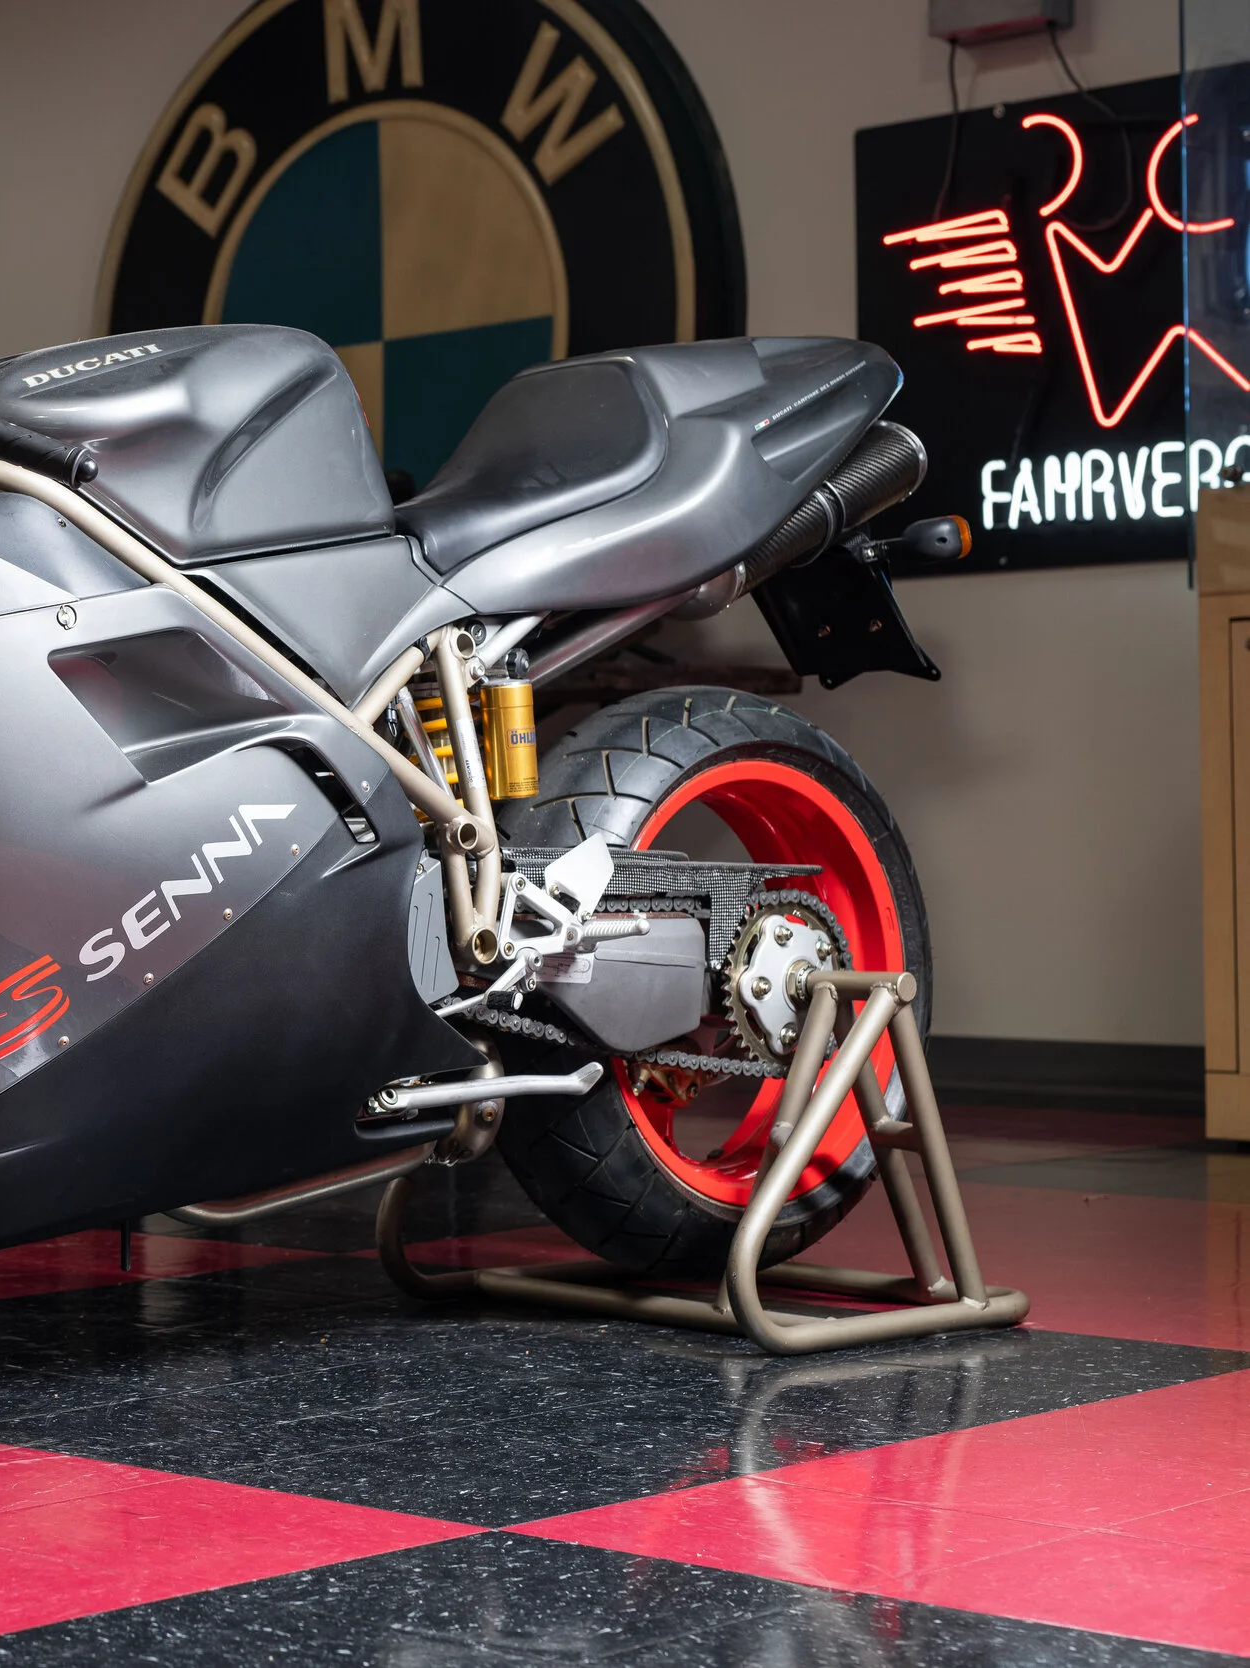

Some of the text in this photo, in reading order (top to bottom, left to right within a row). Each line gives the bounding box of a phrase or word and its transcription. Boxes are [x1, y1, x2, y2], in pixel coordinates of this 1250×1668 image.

[155, 0, 625, 240] BMW
[23, 343, 163, 388] DUCATI
[772, 405, 792, 420] DUCATI
[78, 803, 298, 983] SENNA
